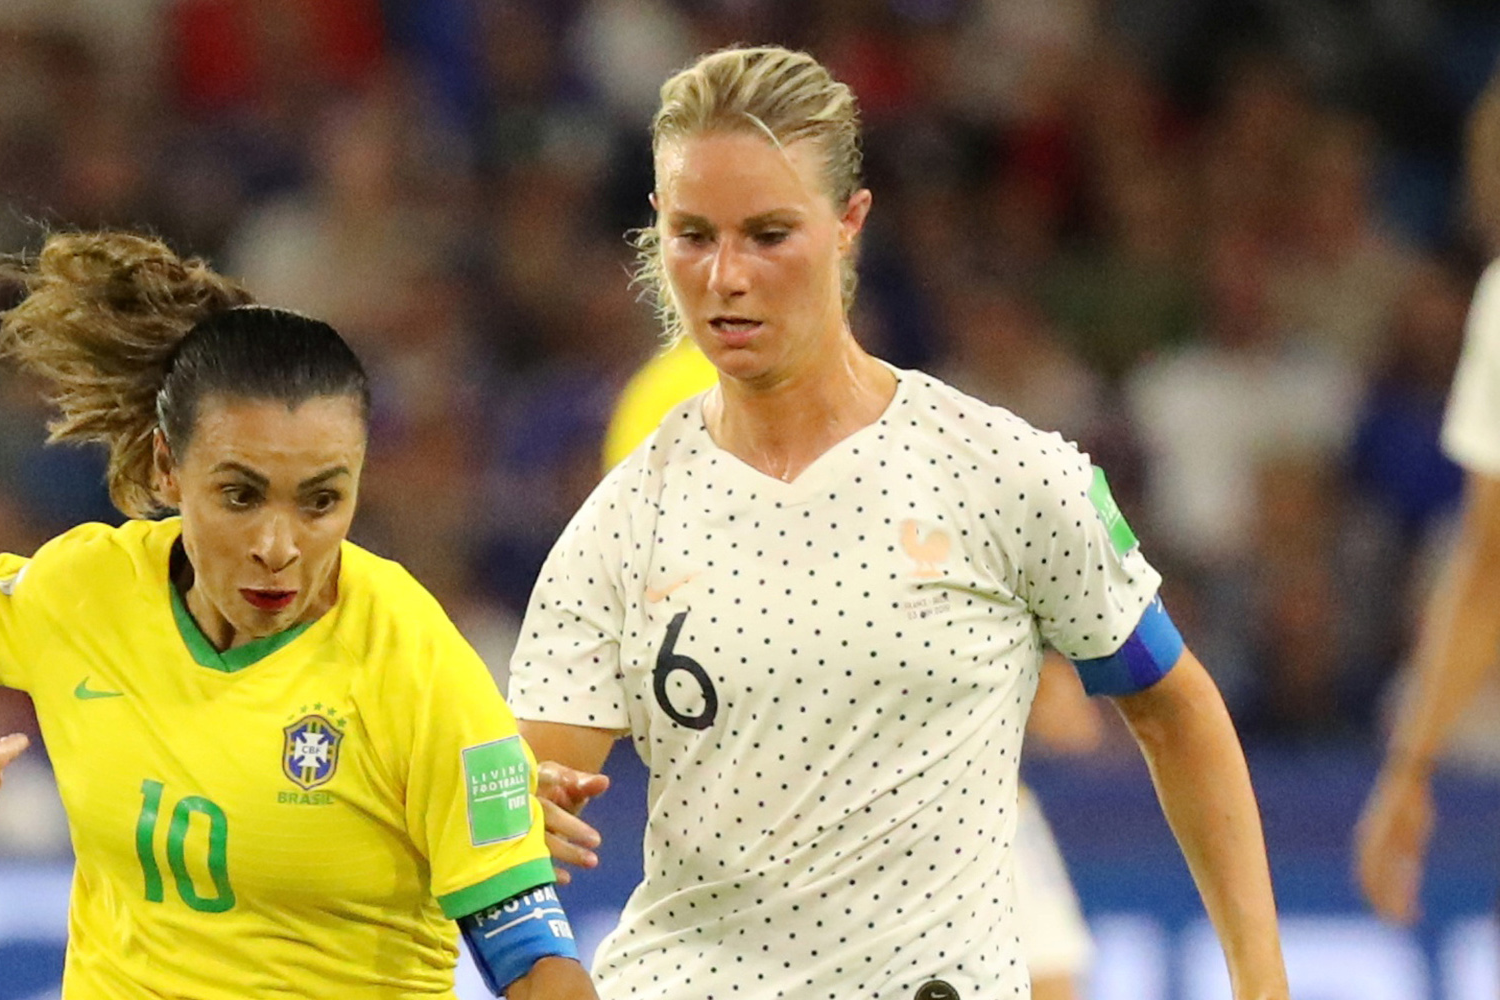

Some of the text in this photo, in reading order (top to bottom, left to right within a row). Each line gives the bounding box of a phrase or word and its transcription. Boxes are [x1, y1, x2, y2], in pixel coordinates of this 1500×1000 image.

[653, 611, 718, 731] 6
[301, 745, 322, 755] CBF
[471, 762, 525, 785] LIVING
[472, 774, 525, 796] FOOTBALL
[277, 790, 335, 806] BRASIL
[135, 778, 236, 913] 10
